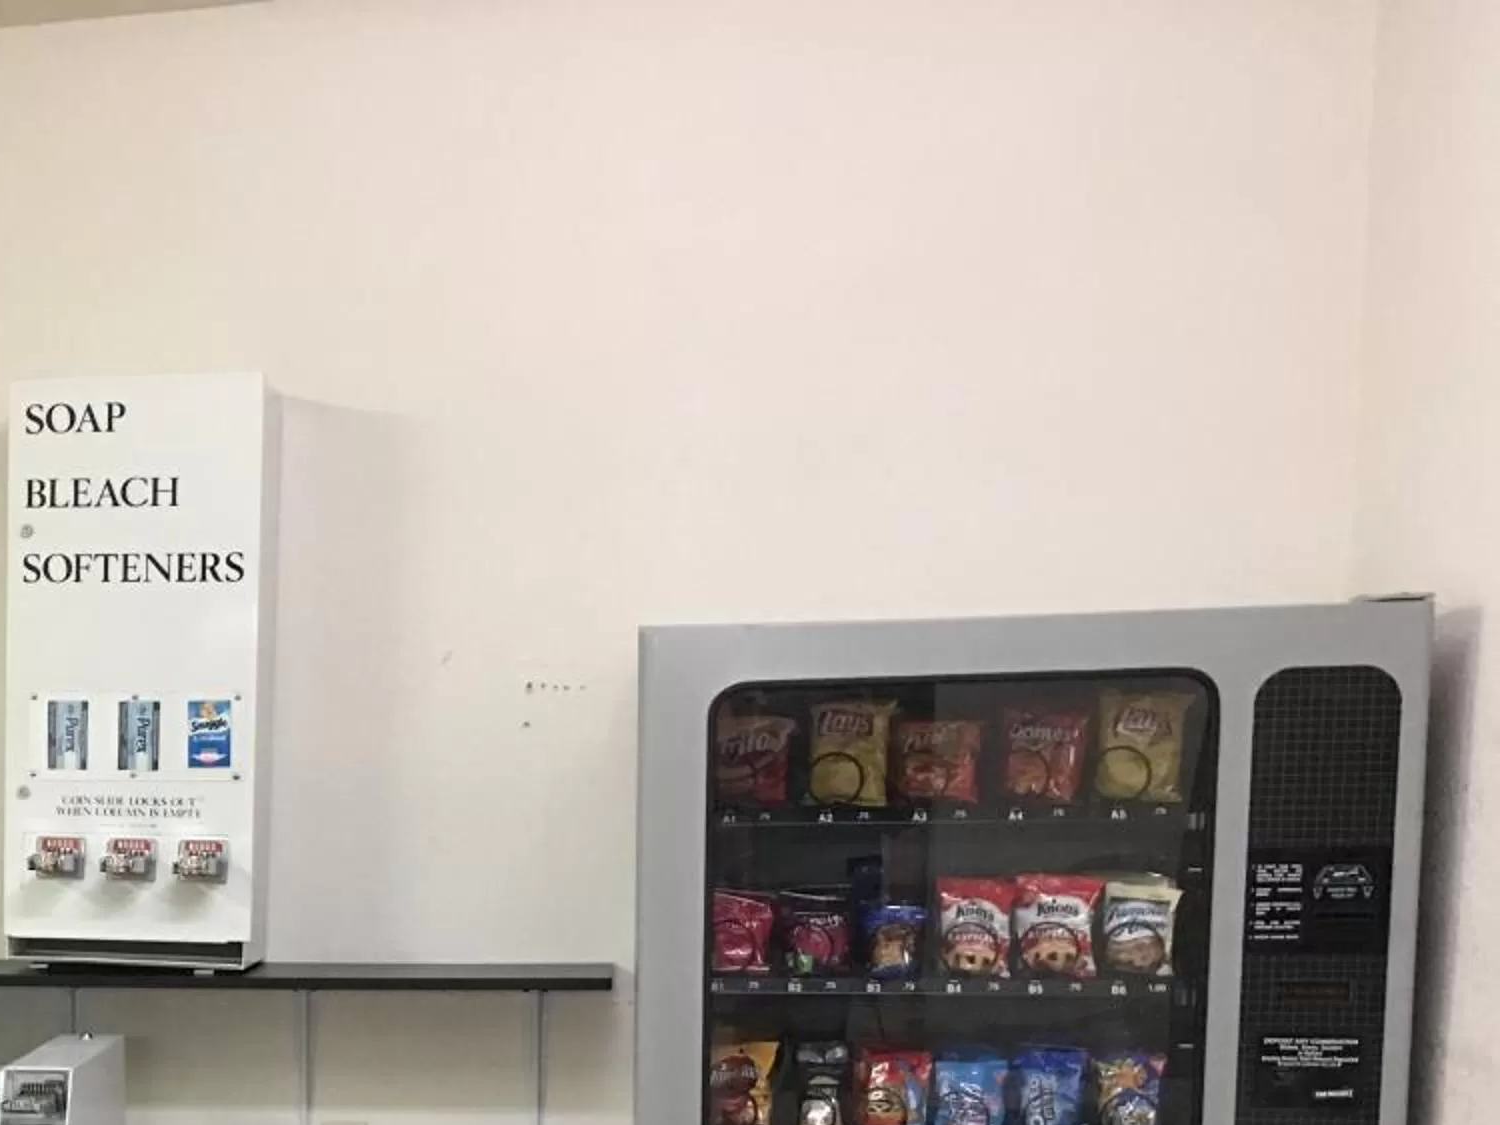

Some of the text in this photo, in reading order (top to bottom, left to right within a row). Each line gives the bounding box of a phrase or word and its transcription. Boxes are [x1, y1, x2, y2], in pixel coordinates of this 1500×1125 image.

[25, 402, 126, 434] SOAP
[26, 476, 180, 508] BLEACH
[23, 552, 245, 583] SOFTENERS
[1009, 810, 1023, 820] A4
